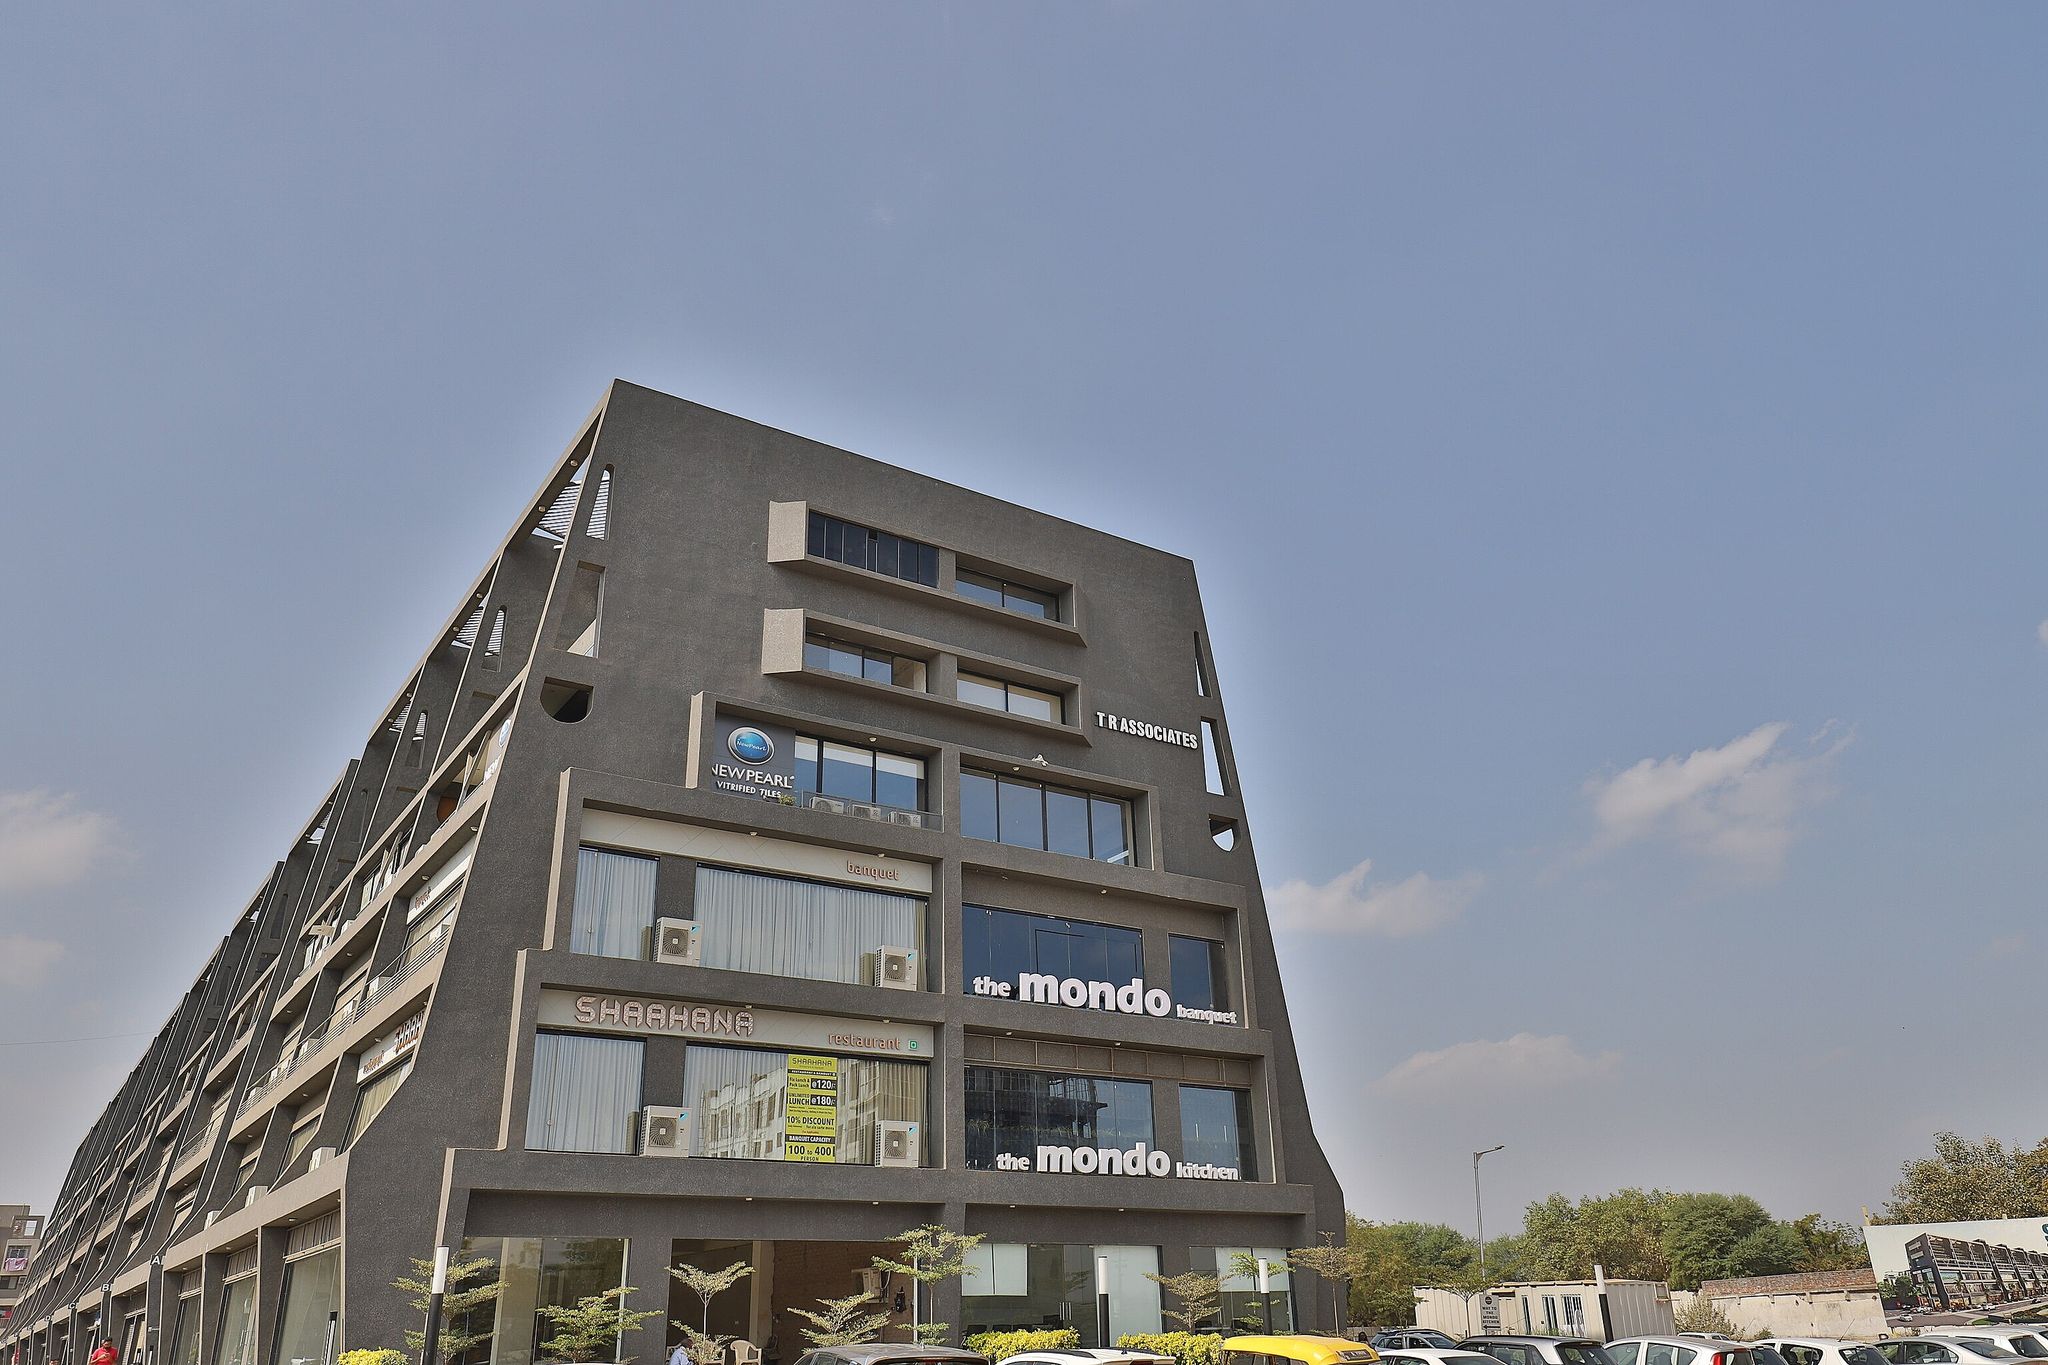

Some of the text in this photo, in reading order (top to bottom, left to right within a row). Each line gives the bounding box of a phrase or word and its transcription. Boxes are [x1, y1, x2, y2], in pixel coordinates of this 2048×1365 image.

[1096, 711, 1198, 749] T R ASSOCIATES
[711, 763, 793, 789] NEWPEARL
[717, 780, 782, 798] VITRIFIED TILES
[846, 860, 899, 880] banquet
[972, 972, 1237, 1025] the mondo banquet
[575, 995, 754, 1037] SHAAHANA
[828, 1033, 900, 1050] restaurant
[789, 1097, 810, 1105] LUNCH
[787, 1115, 801, 1123] 10%
[802, 1117, 834, 1126] DISCOUNT
[788, 1145, 805, 1155] 100
[814, 1146, 831, 1156] 400
[996, 1143, 1239, 1180] the mondo kitchen
[151, 1255, 161, 1265] A
[102, 1283, 110, 1292] B
